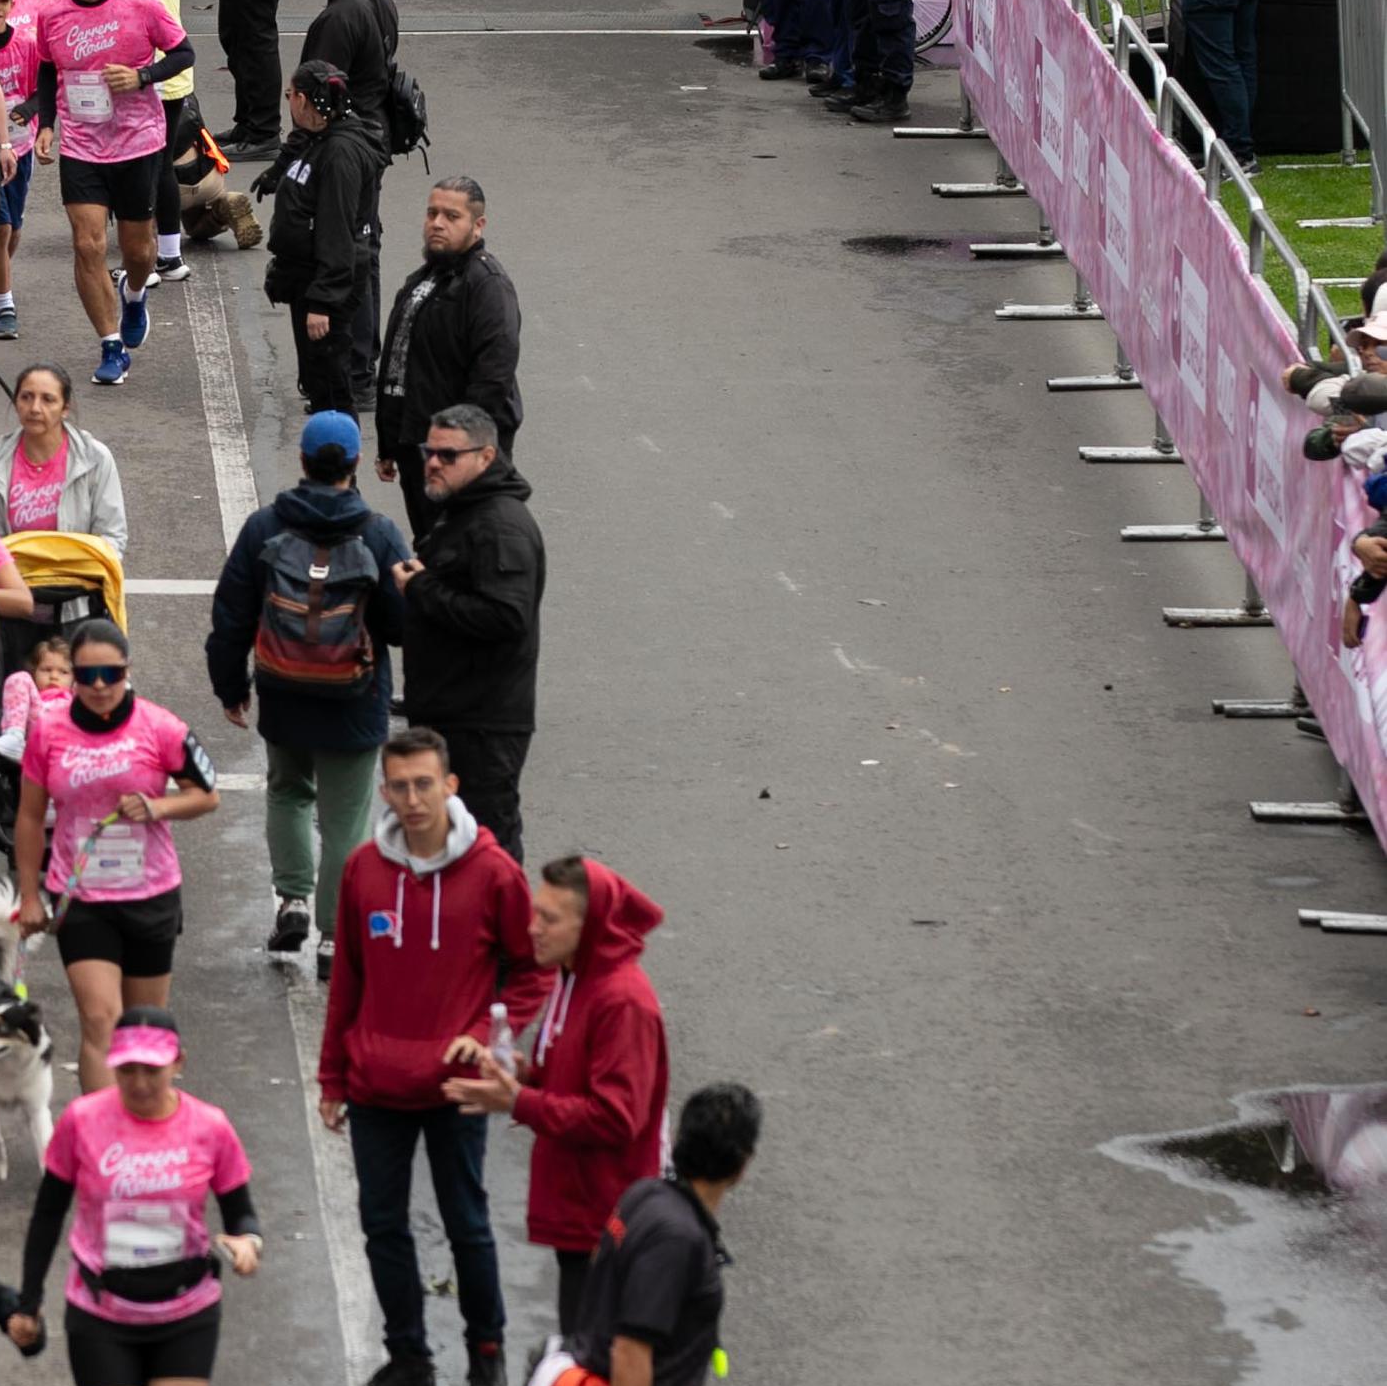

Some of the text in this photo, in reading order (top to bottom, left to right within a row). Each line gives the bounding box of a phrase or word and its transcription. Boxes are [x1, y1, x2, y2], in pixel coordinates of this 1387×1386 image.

[66, 20, 119, 46] Carrera
[74, 37, 116, 61] Rosas
[99, 1142, 189, 1178] Carrera
